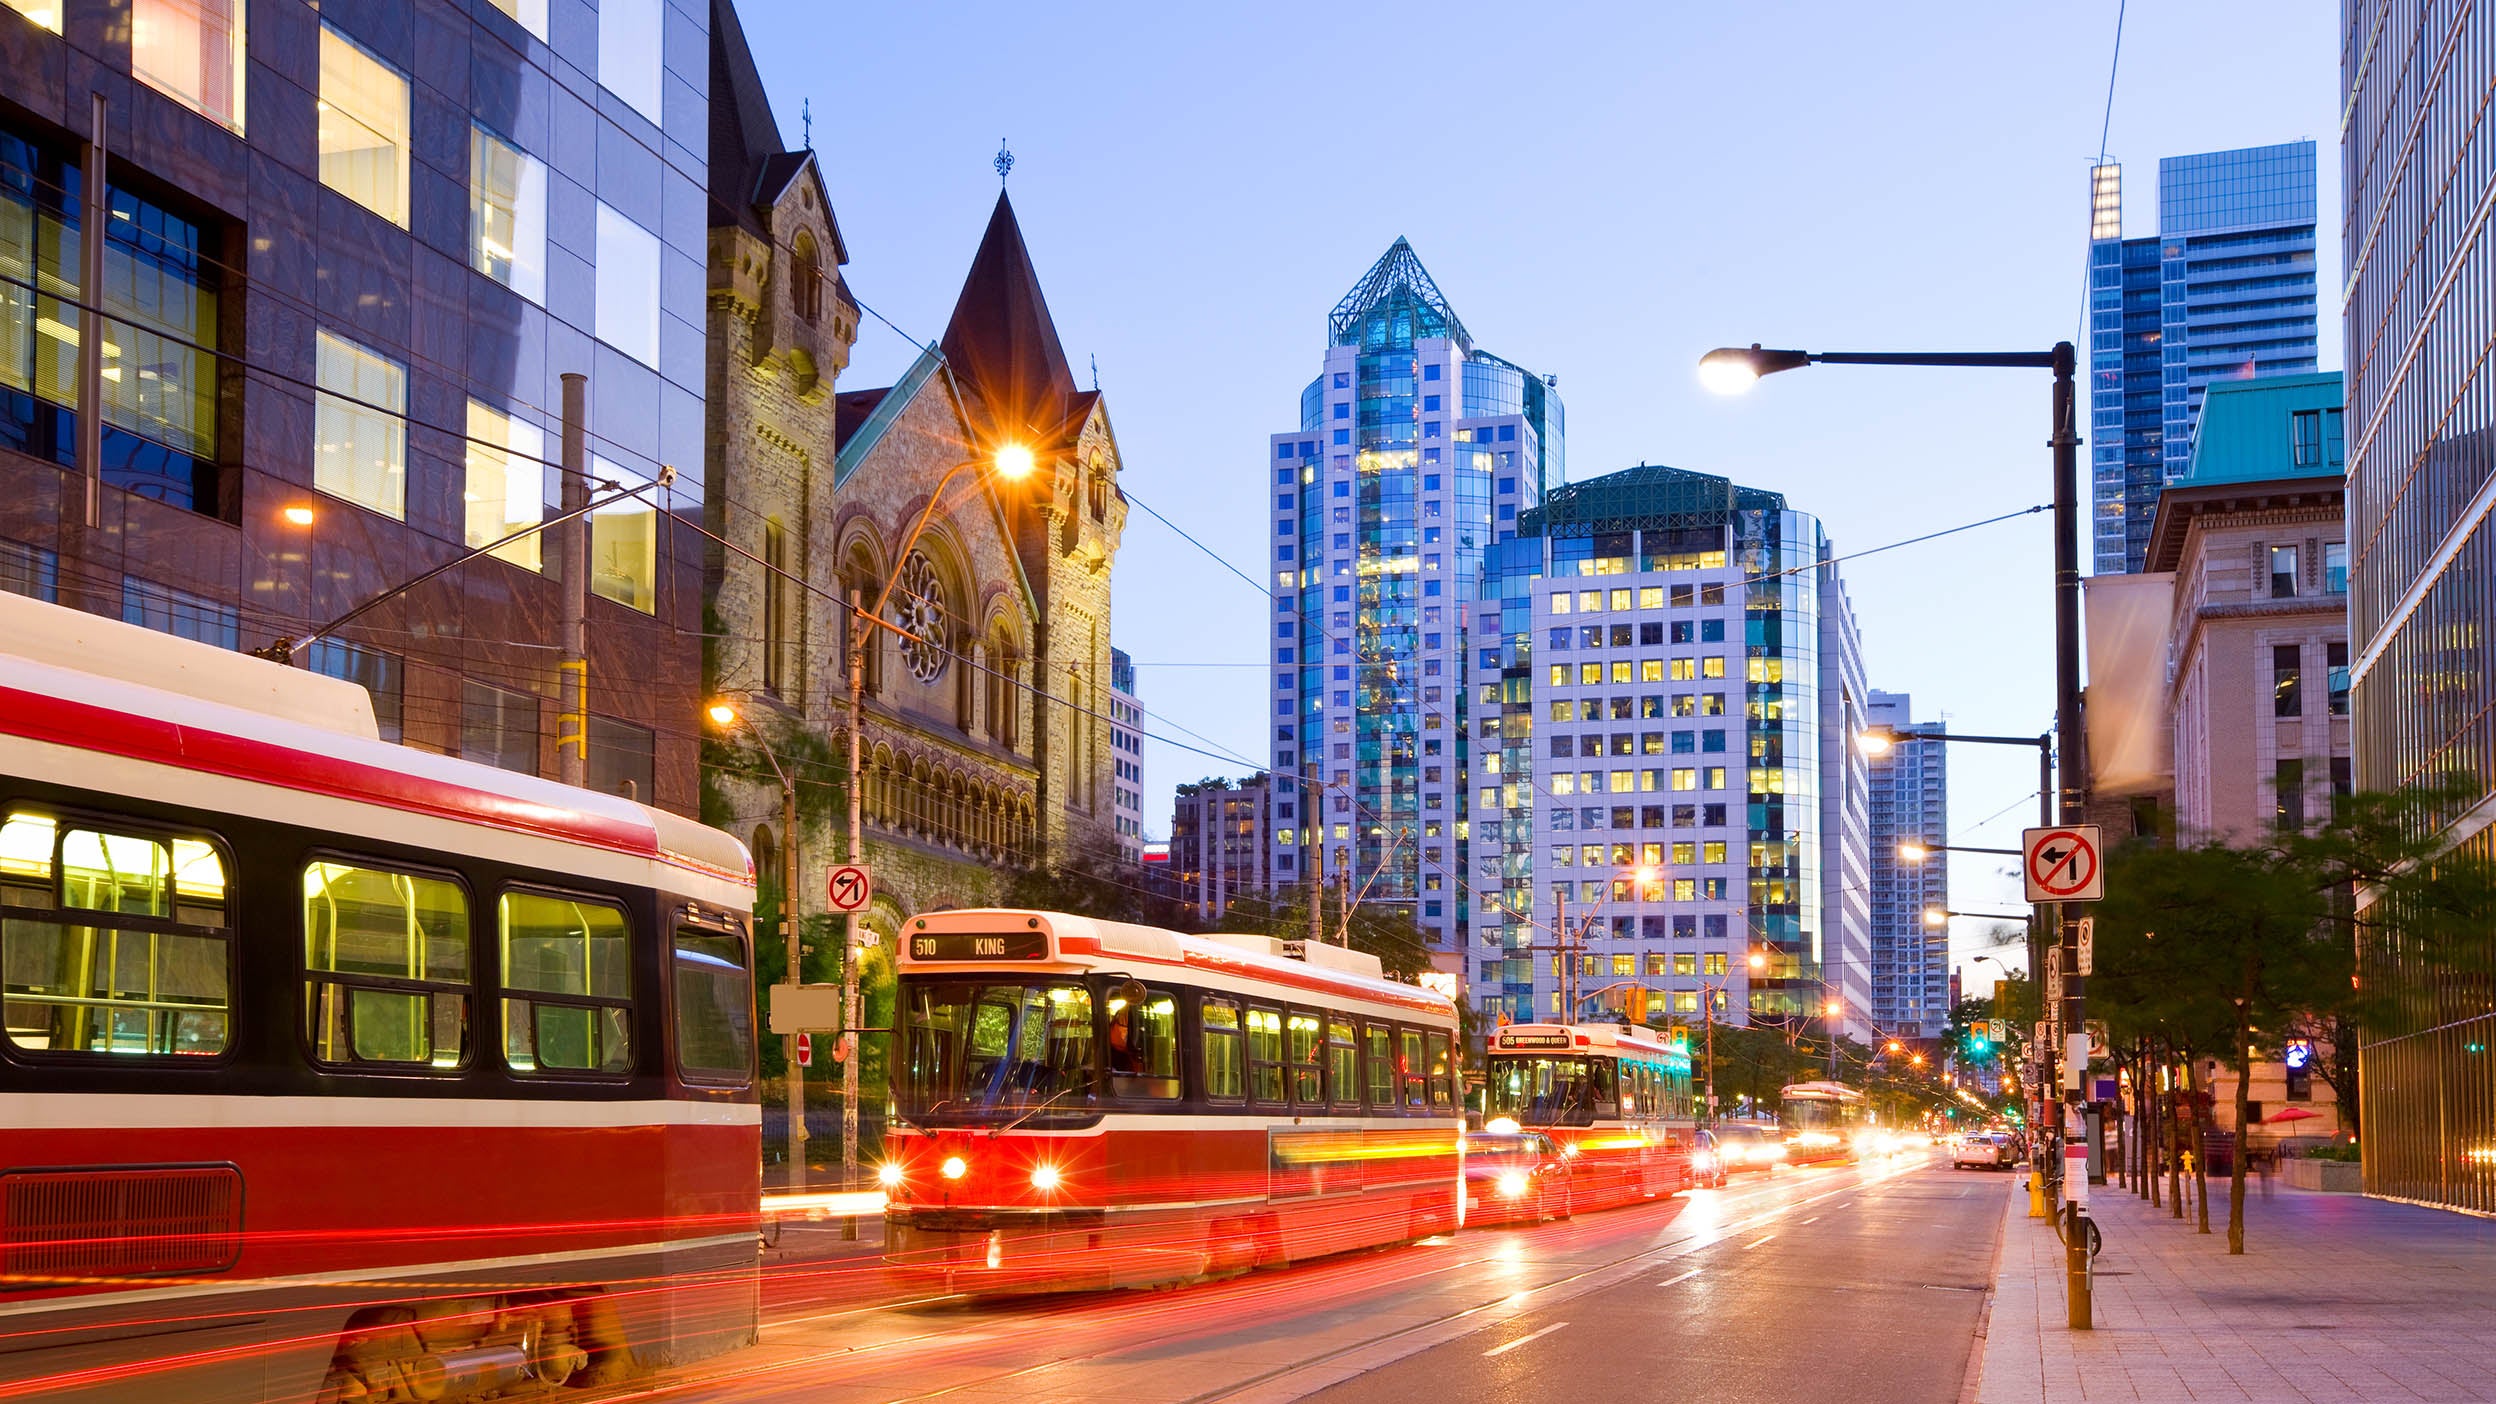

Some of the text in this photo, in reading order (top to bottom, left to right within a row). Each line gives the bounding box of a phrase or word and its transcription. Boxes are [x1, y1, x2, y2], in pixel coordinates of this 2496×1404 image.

[916, 938, 1005, 955] 510 KING
[1502, 1036, 1515, 1045] 505
[1550, 1037, 1567, 1045] QUEEN
